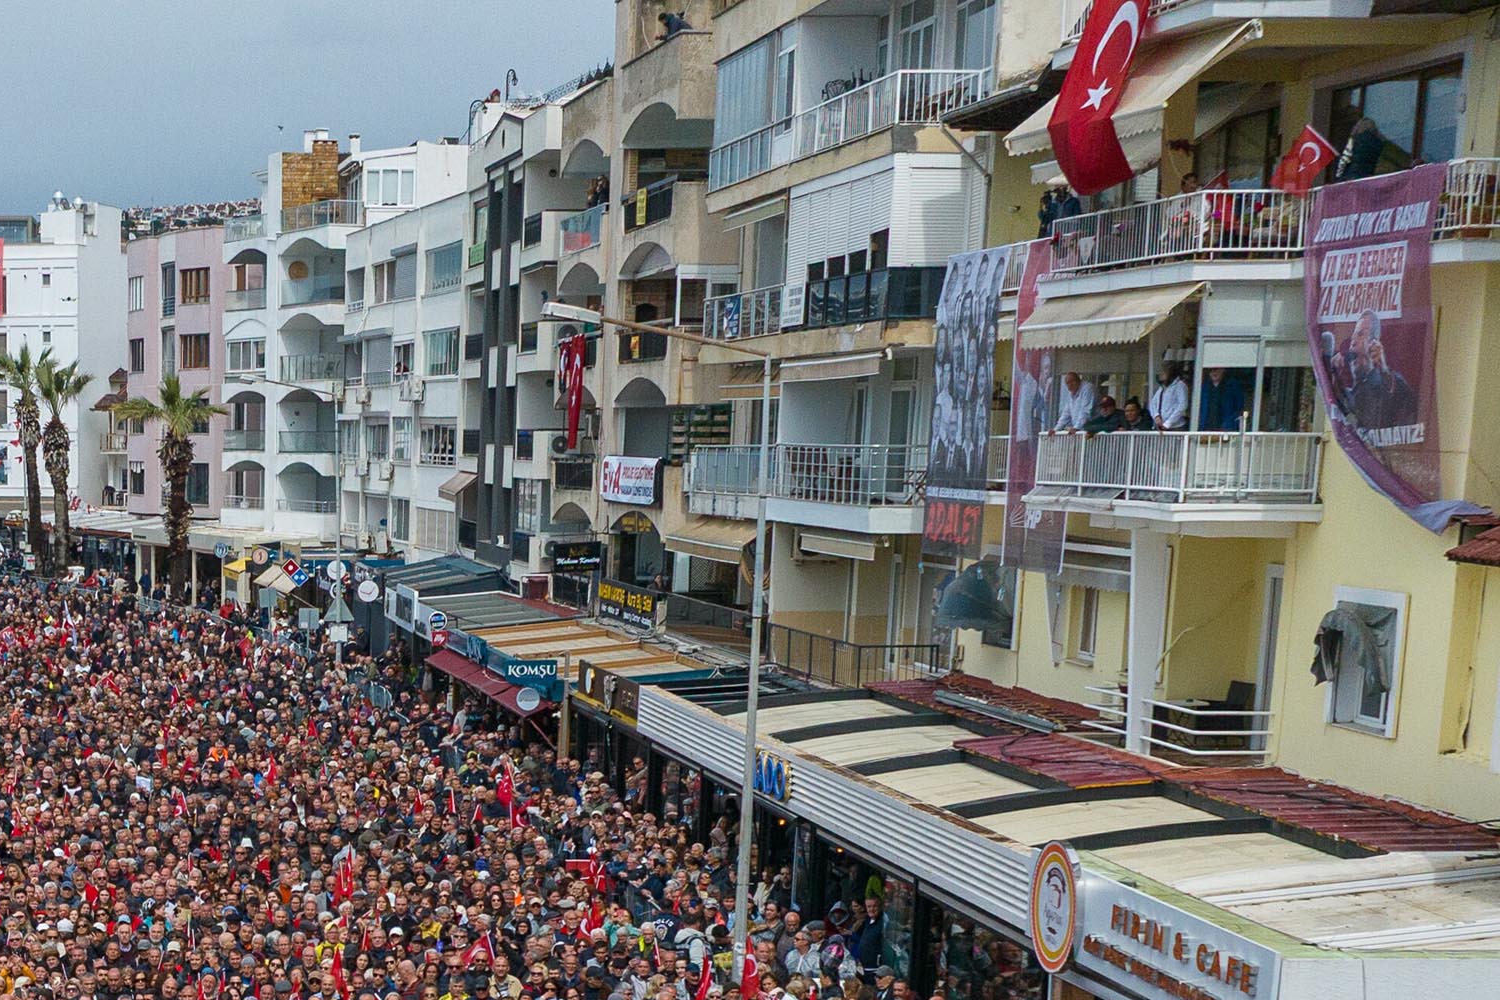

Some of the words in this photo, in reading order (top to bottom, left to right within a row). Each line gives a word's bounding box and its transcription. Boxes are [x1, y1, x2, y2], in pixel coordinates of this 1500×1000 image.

[1323, 256, 1337, 281] YA
[1338, 253, 1357, 280] HEP
[1358, 246, 1405, 278] BERABER
[924, 501, 981, 545] ADALET
[508, 664, 556, 679] KOMŞU
[1110, 904, 1166, 954] FIRIN
[1172, 931, 1189, 963] &
[1196, 943, 1259, 997] CAFE
